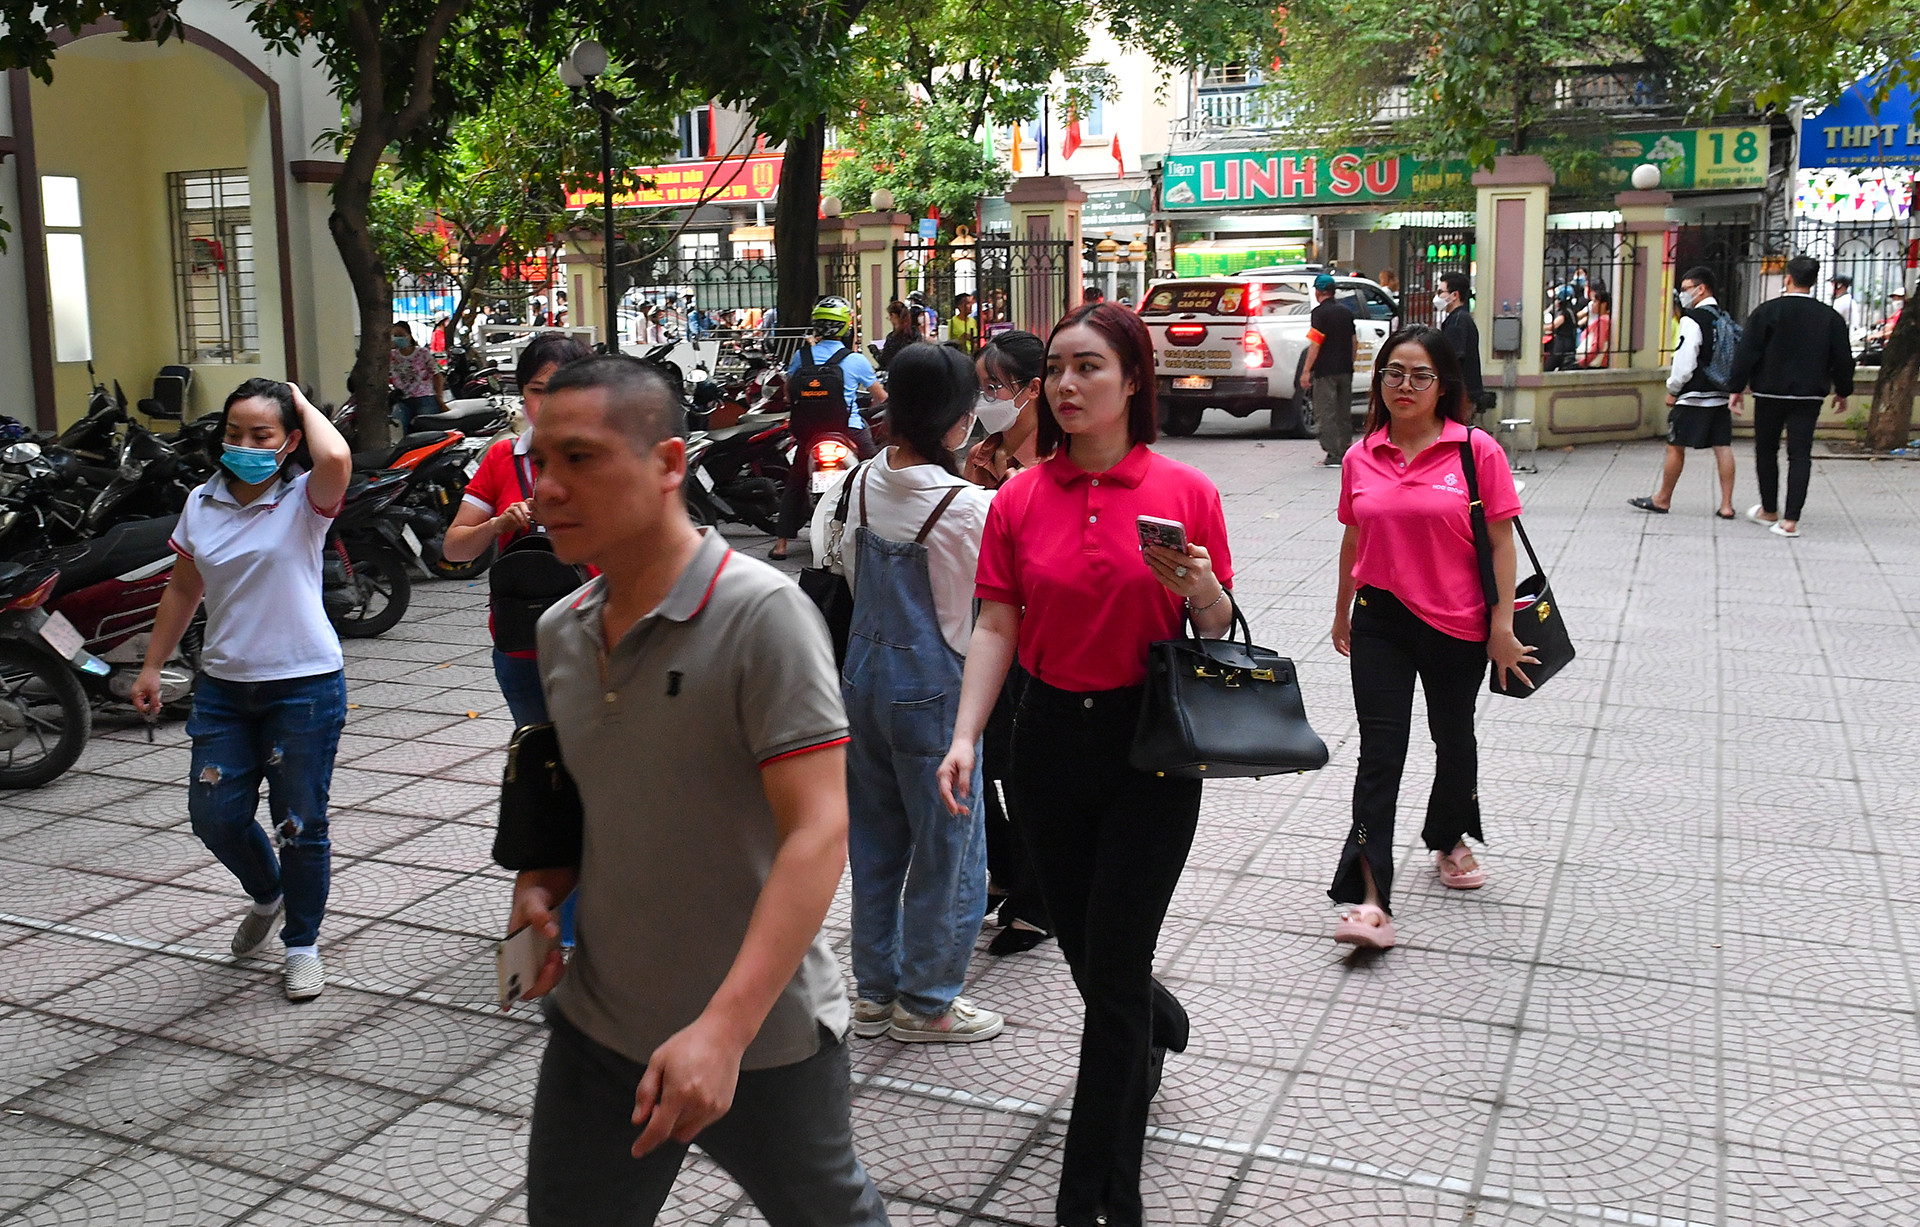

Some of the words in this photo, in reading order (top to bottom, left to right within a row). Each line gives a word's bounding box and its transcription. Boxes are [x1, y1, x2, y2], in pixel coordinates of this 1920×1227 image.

[1708, 131, 1758, 165] 18
[1823, 124, 1899, 149] THPT
[1167, 161, 1195, 176] Tiệm
[1200, 156, 1317, 201] LINH
[1178, 300, 1195, 308] CAO
